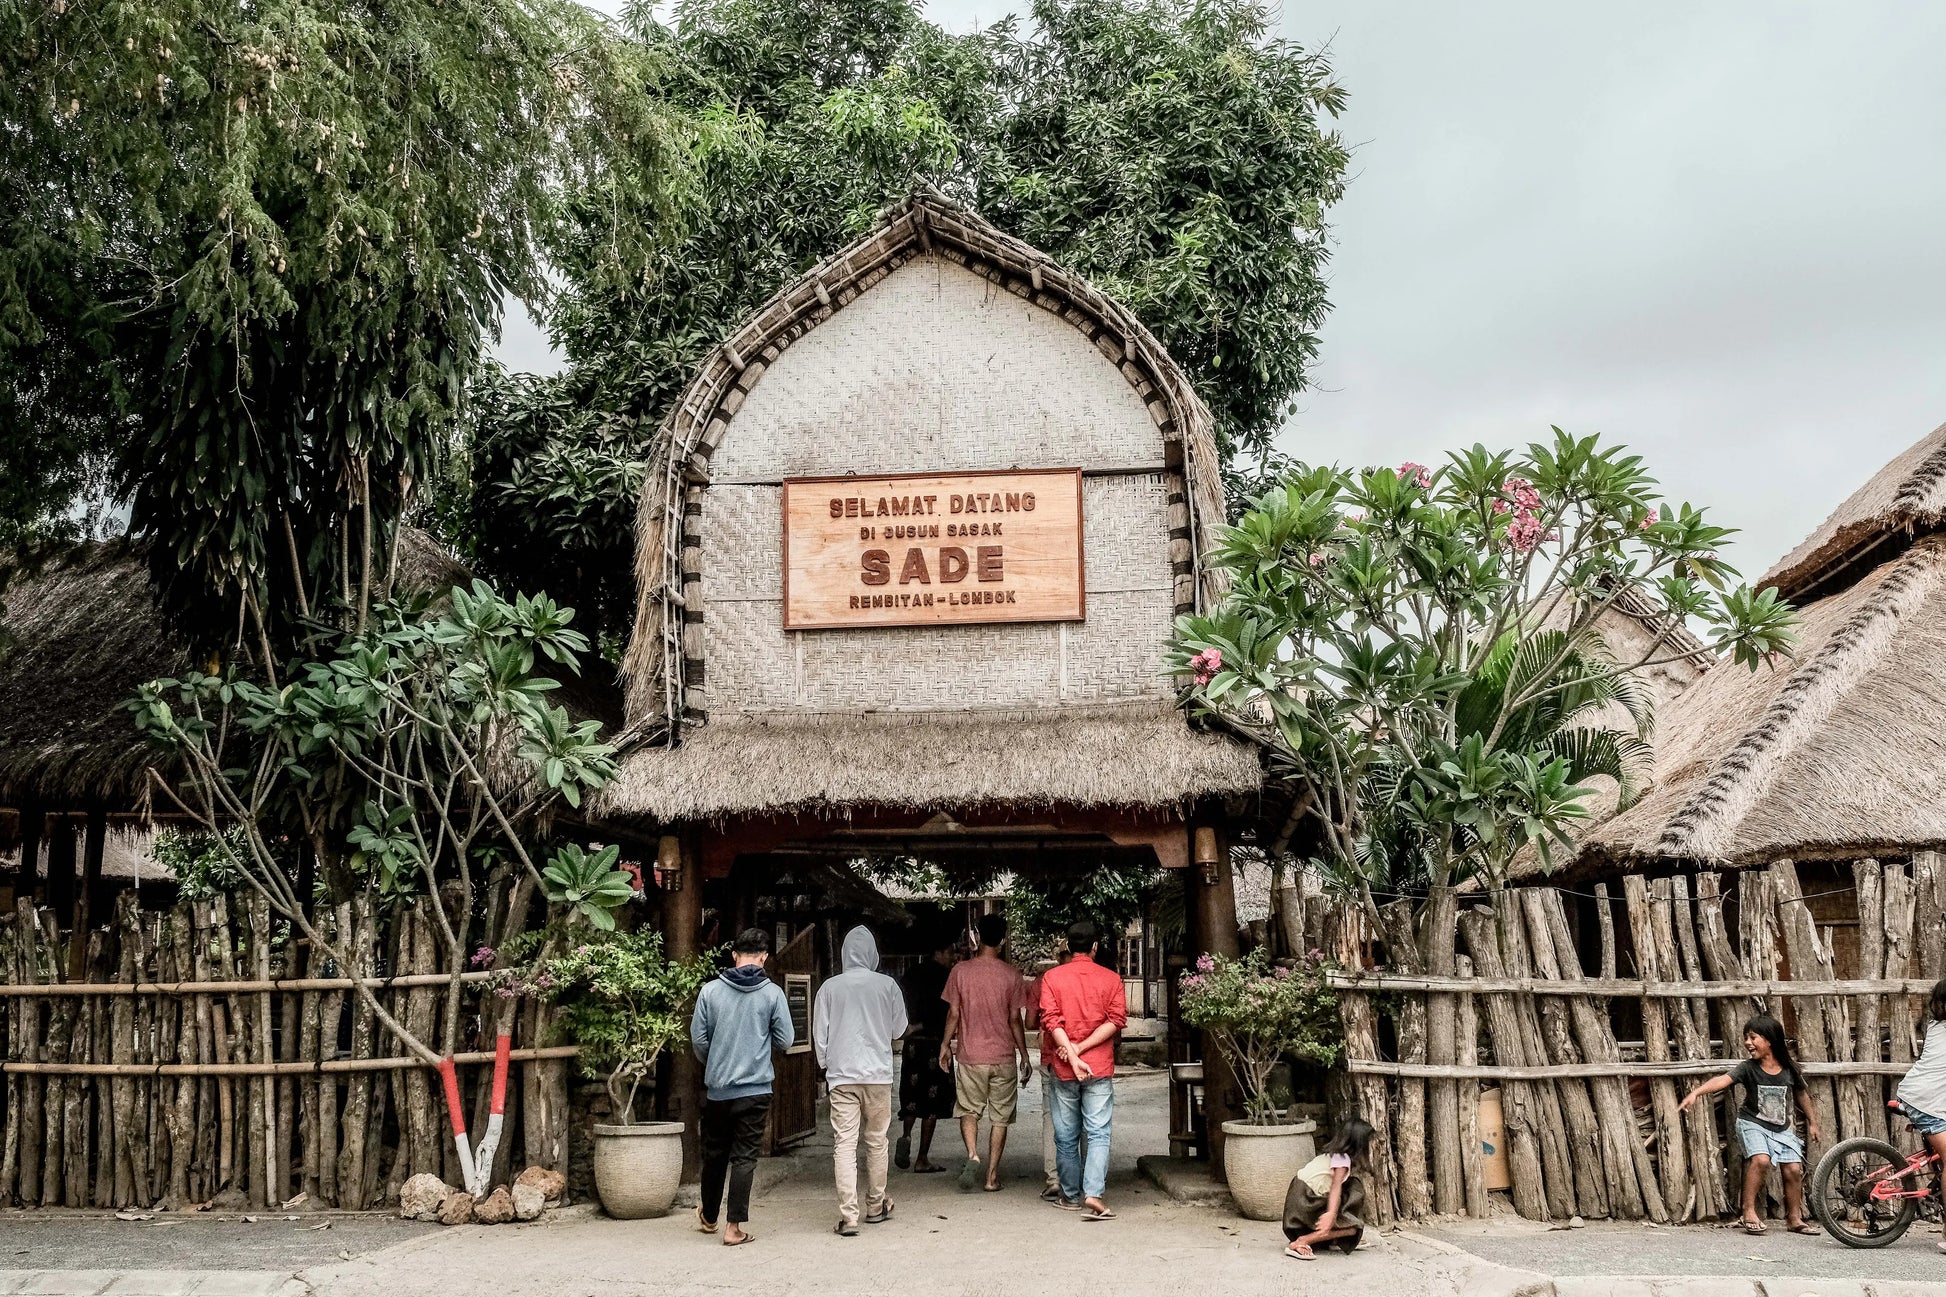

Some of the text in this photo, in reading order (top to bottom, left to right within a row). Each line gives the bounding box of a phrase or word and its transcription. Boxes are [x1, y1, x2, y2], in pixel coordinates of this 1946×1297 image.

[829, 491, 1036, 518] SELAMAT DATANG
[860, 526, 876, 541] DI
[947, 522, 1003, 537] SASAK
[860, 545, 1004, 586] SADE
